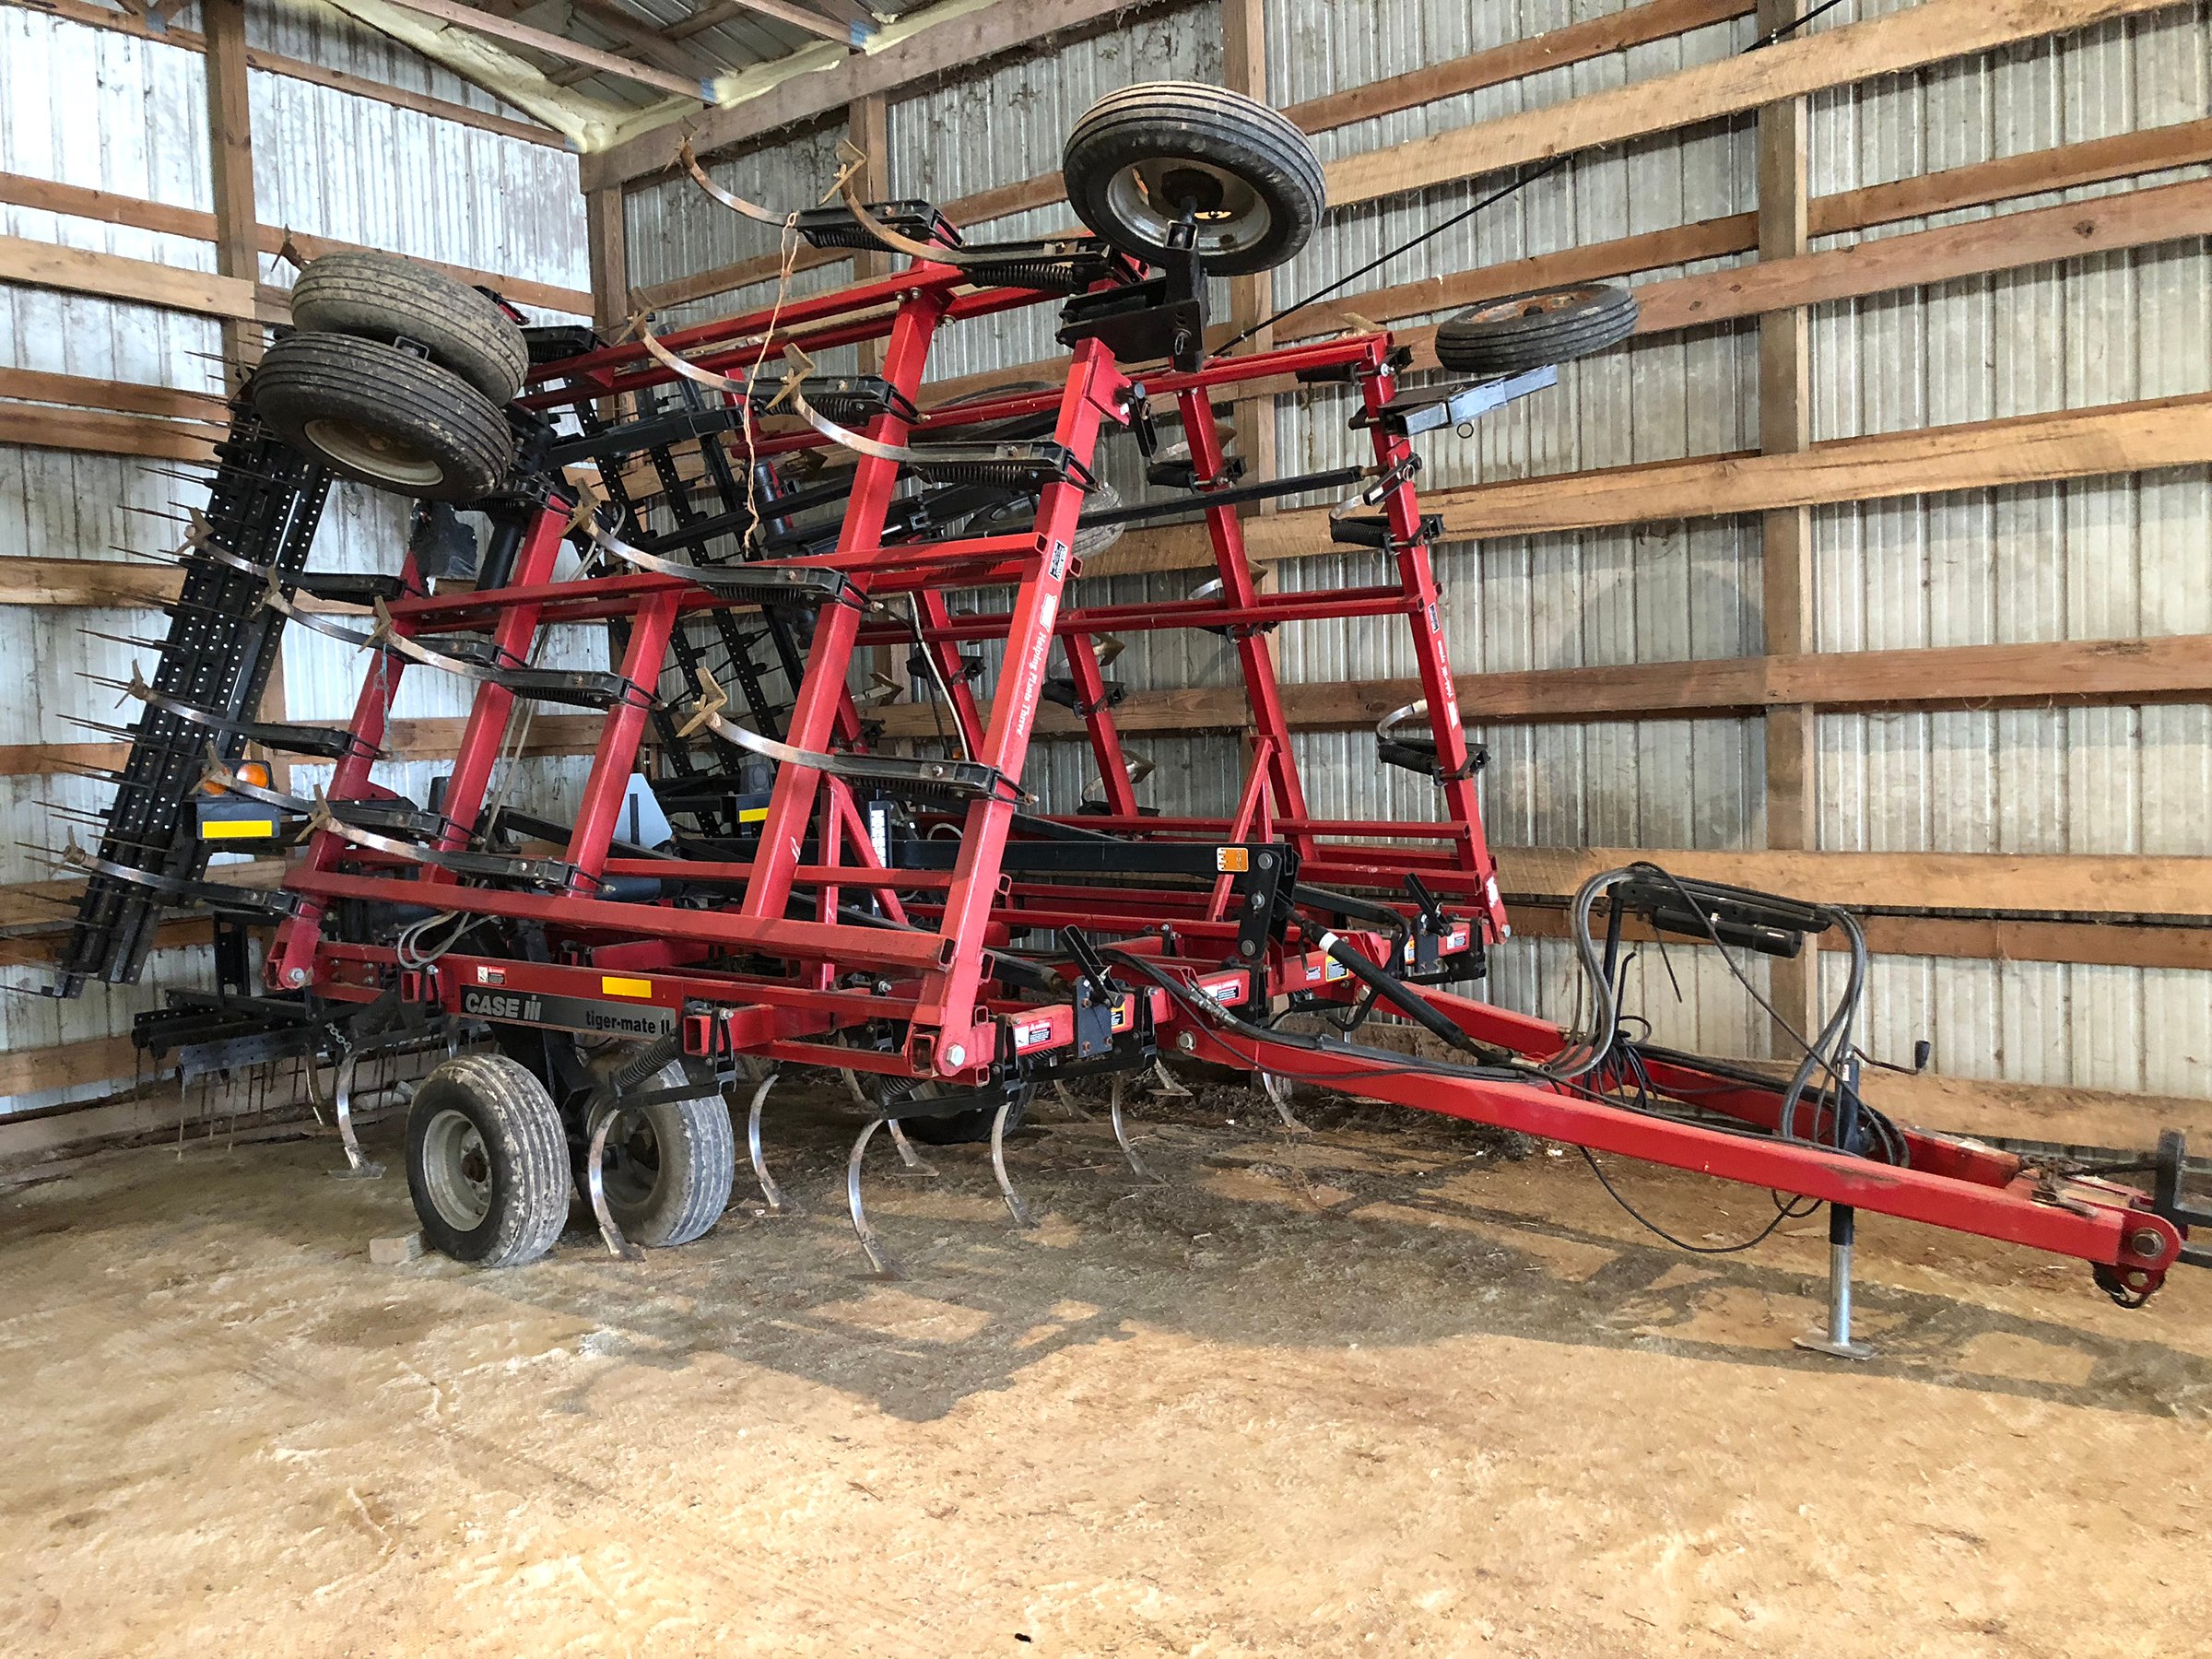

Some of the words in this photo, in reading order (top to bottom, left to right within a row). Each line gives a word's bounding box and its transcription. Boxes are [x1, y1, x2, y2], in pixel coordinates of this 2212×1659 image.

[1029, 631, 1047, 672] Helping
[1024, 672, 1038, 702] Plants
[465, 993, 520, 1018] CASE
